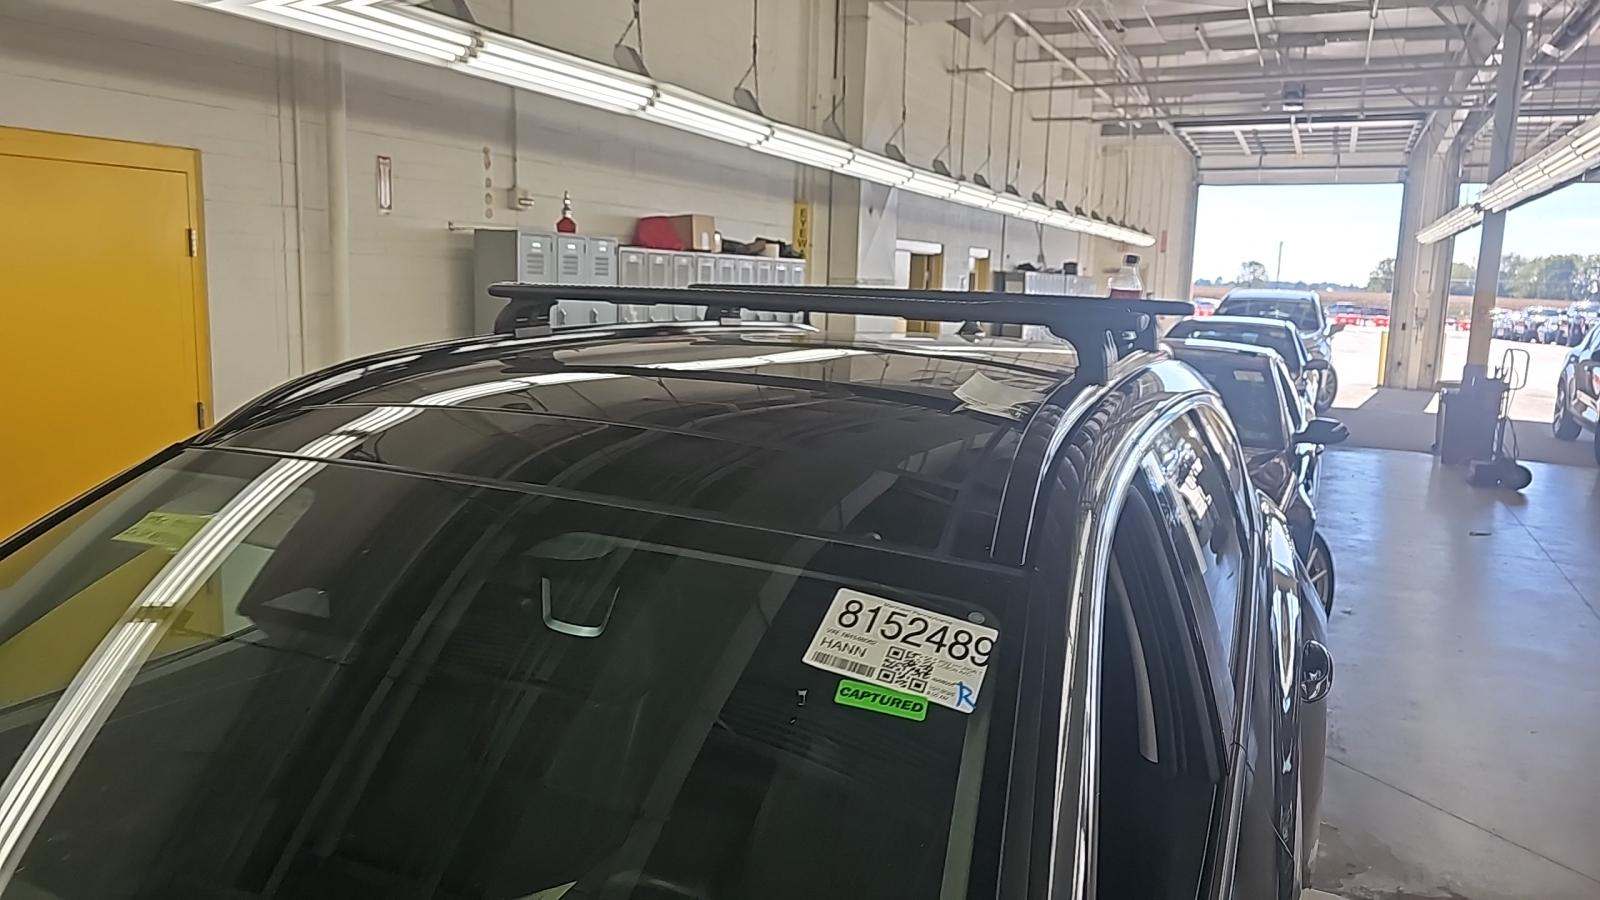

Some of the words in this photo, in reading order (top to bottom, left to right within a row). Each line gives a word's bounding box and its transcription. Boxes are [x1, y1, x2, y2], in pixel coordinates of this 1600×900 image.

[820, 636, 868, 658] HANN
[838, 599, 995, 667] 8152489
[839, 686, 924, 714] CAPTURED
[954, 681, 976, 709] R
